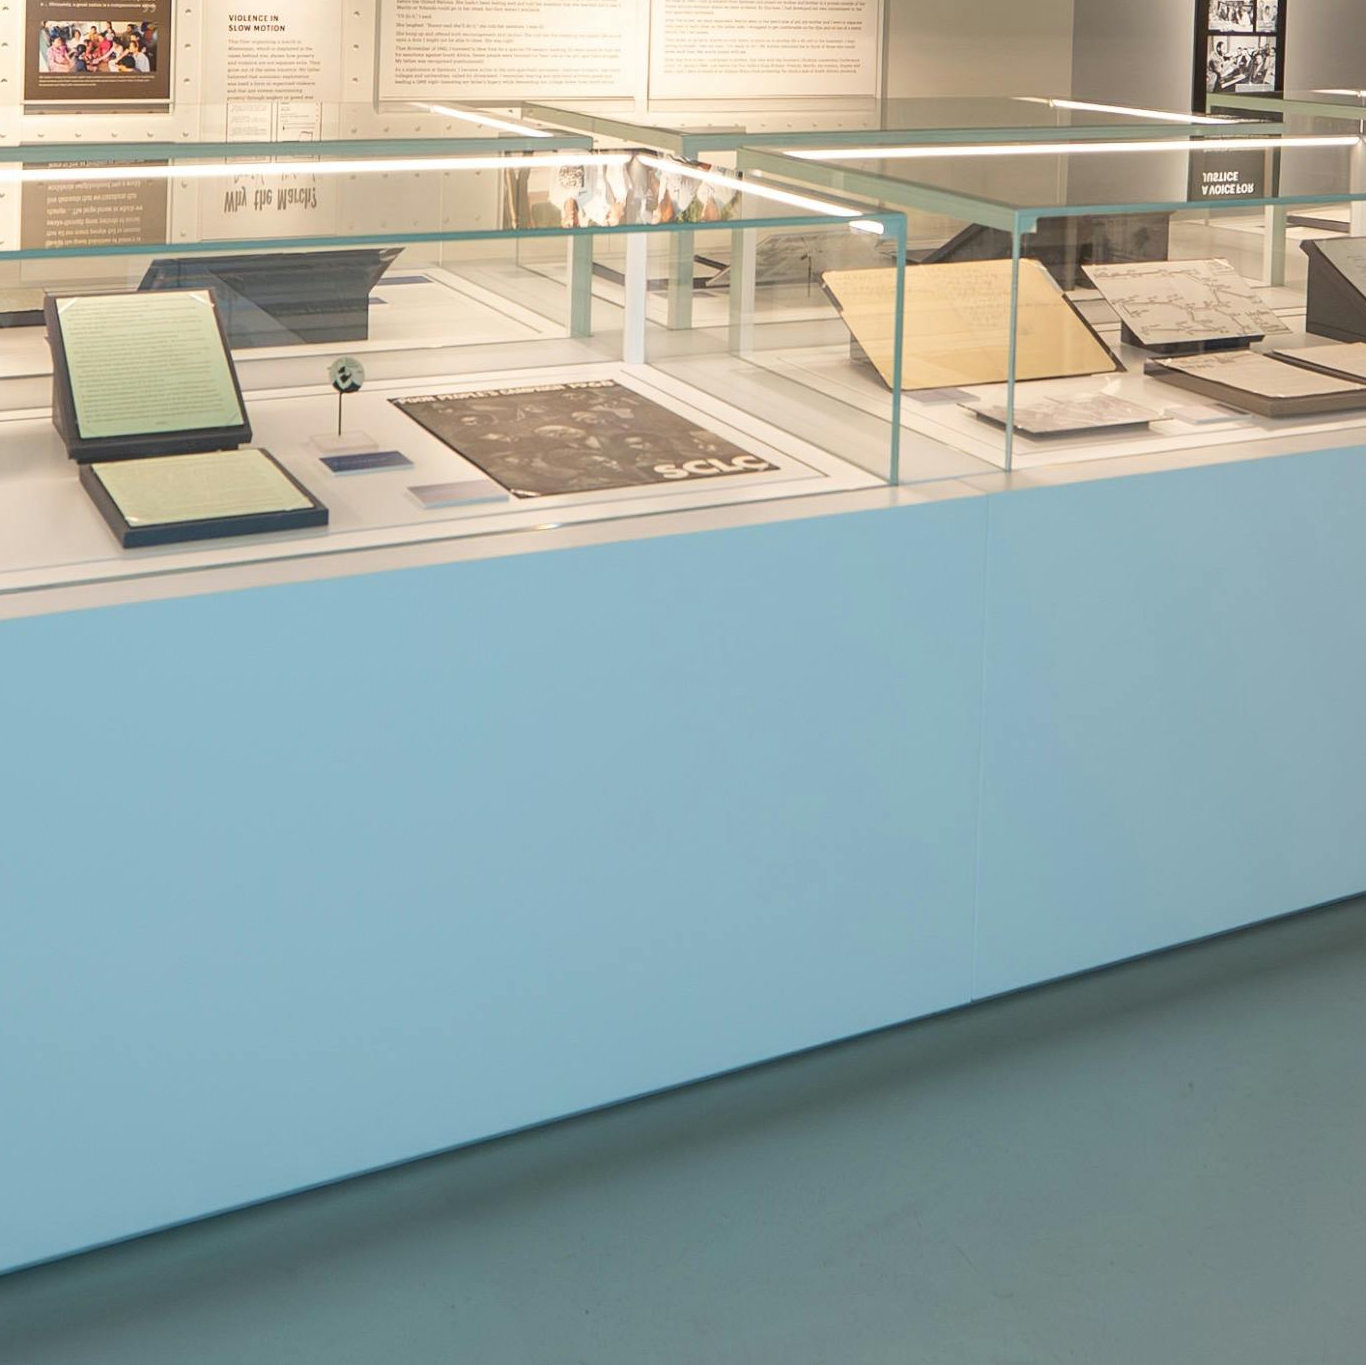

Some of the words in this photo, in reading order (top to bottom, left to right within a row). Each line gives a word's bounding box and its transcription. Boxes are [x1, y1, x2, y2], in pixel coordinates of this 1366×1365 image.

[228, 14, 268, 22] VIOLENCE
[228, 24, 251, 32] SLOW
[653, 454, 768, 480] SCLC
